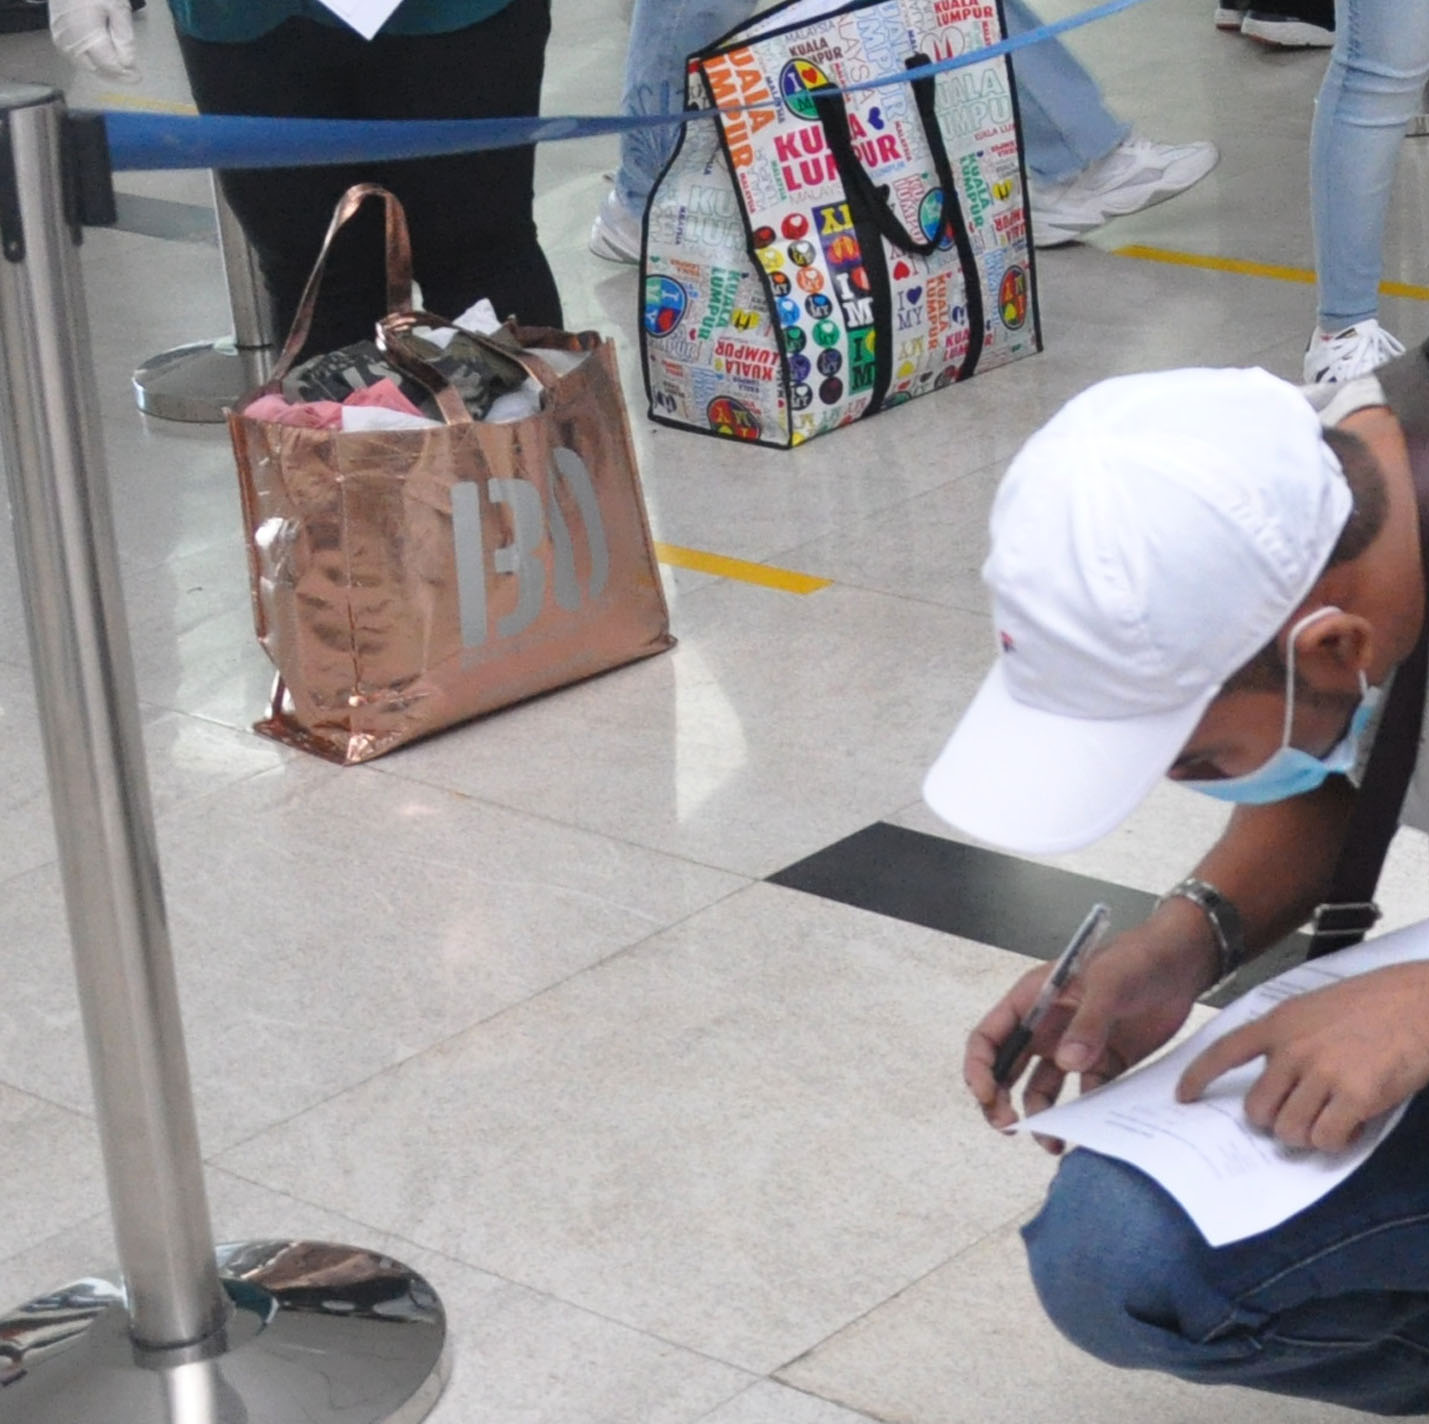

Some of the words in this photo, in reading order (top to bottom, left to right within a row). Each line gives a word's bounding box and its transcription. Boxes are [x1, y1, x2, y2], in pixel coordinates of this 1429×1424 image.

[937, 6, 993, 27] LUMPUR
[789, 37, 829, 58] KUALA
[774, 113, 867, 162] KUA
[960, 155, 985, 229] LUMPUR
[967, 152, 992, 210] KUALA
[898, 307, 923, 331] MY
[715, 341, 781, 366] LUMPUR
[726, 359, 773, 382] KUALA
